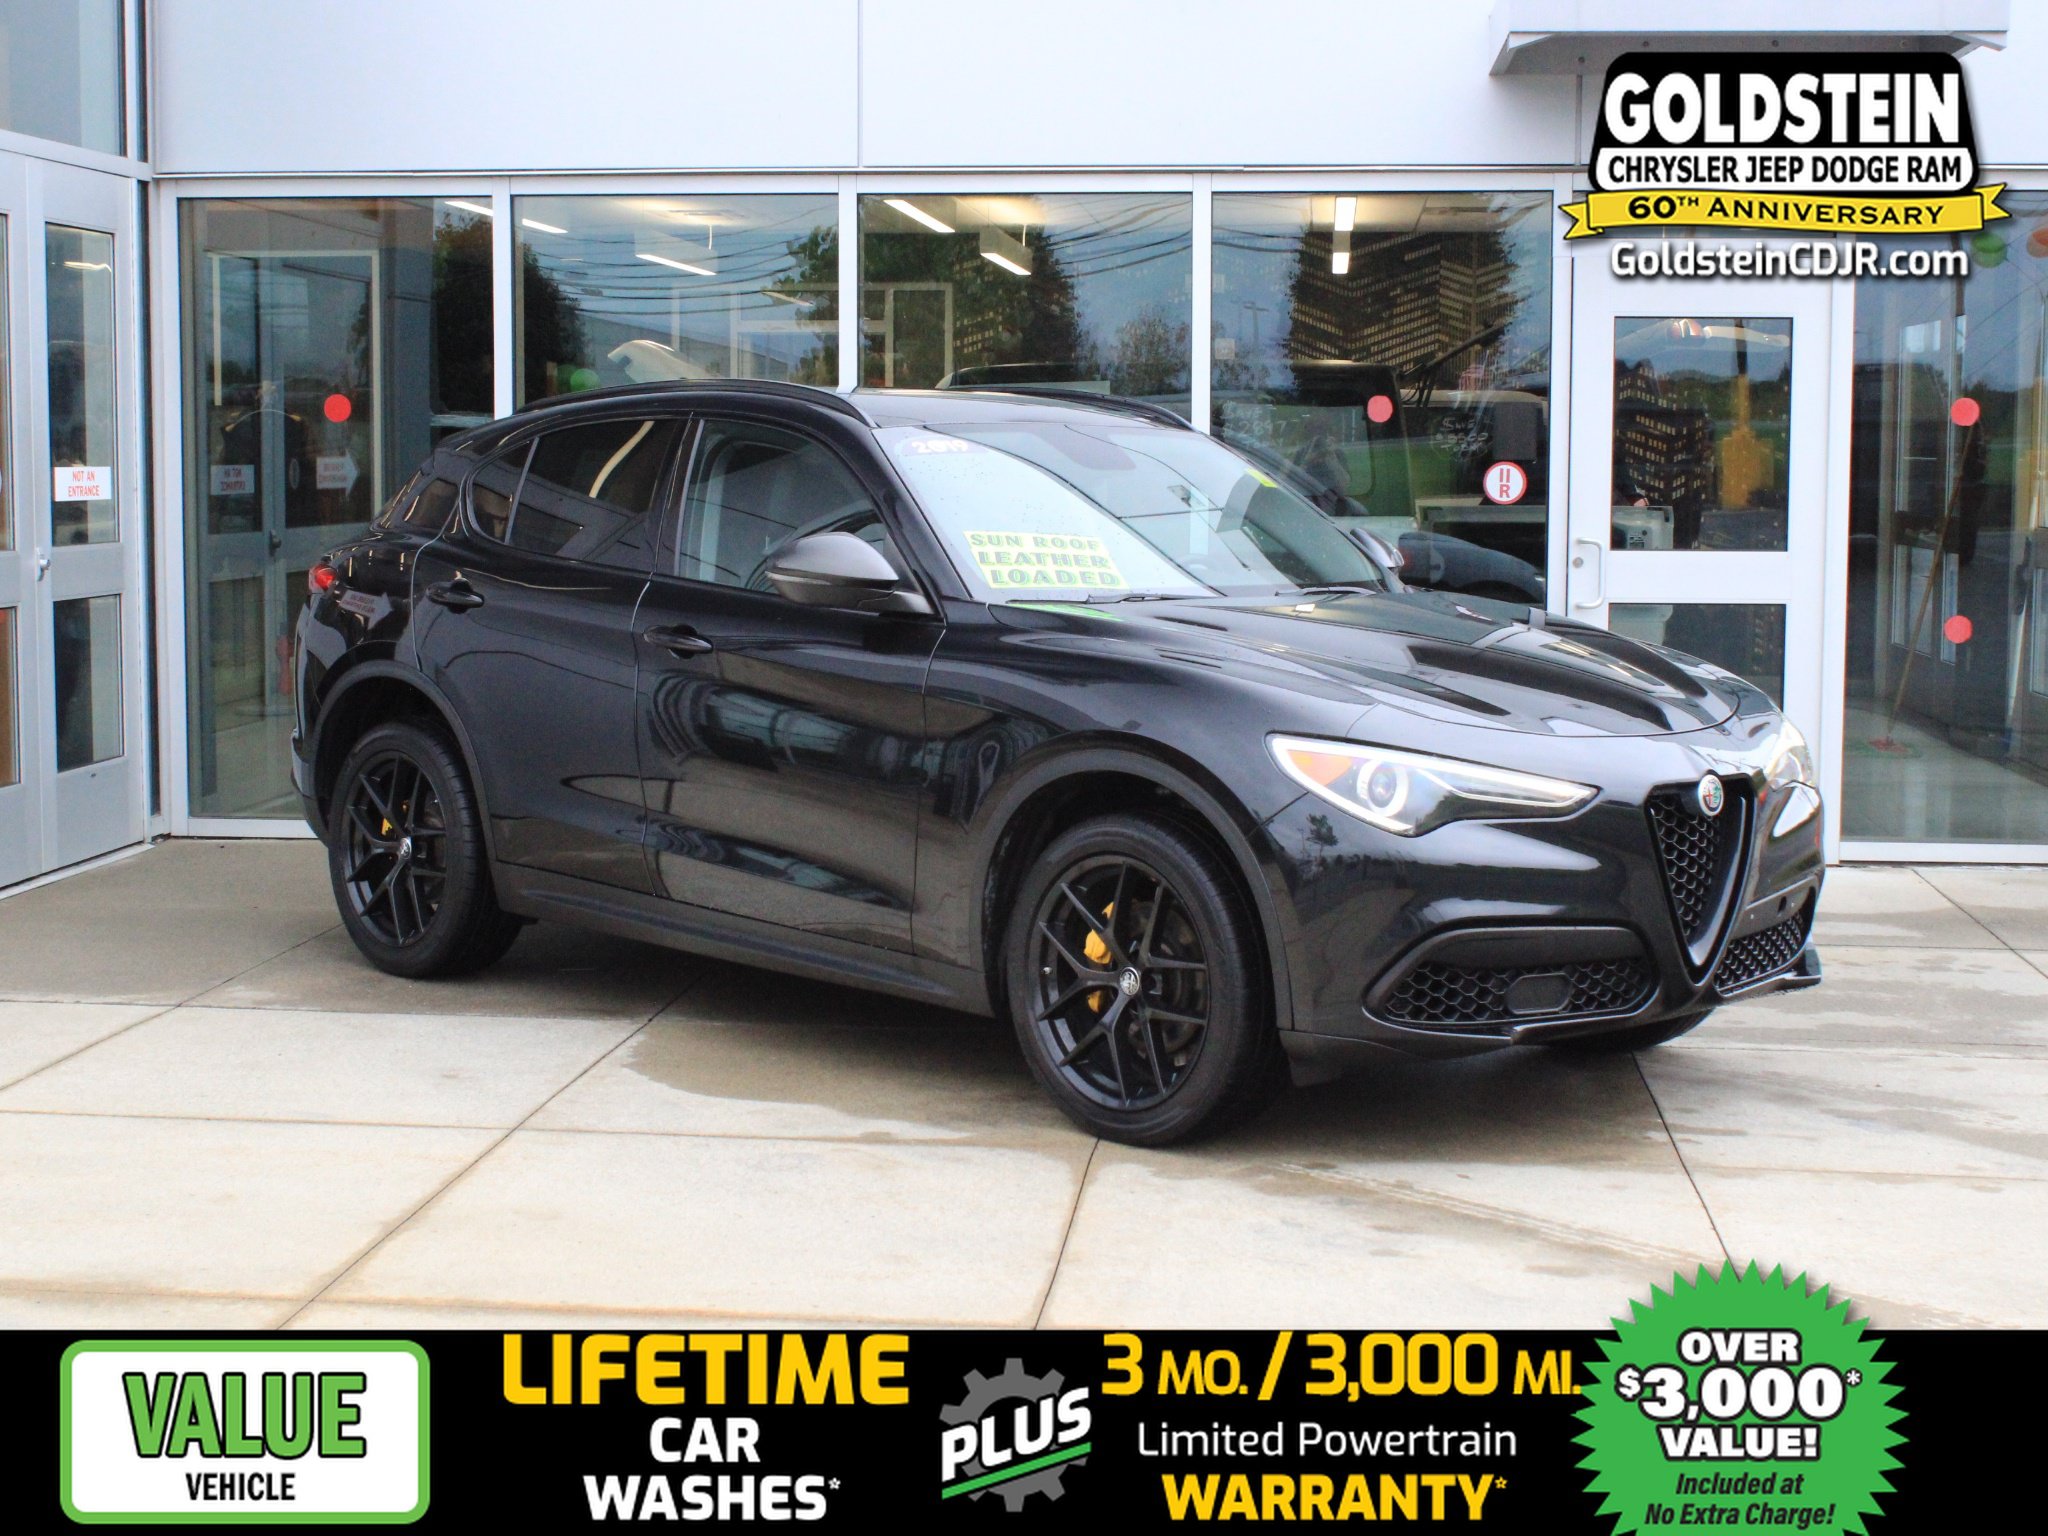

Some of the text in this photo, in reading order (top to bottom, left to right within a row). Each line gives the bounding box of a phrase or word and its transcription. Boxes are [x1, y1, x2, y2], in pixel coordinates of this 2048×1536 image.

[72, 470, 95, 482] NOT AN
[68, 485, 100, 498] ENTRANCE
[1499, 483, 1511, 498] R
[969, 533, 1101, 552] SUN ROOF
[977, 550, 1112, 569] LEATHER
[990, 568, 1121, 587] LOADED
